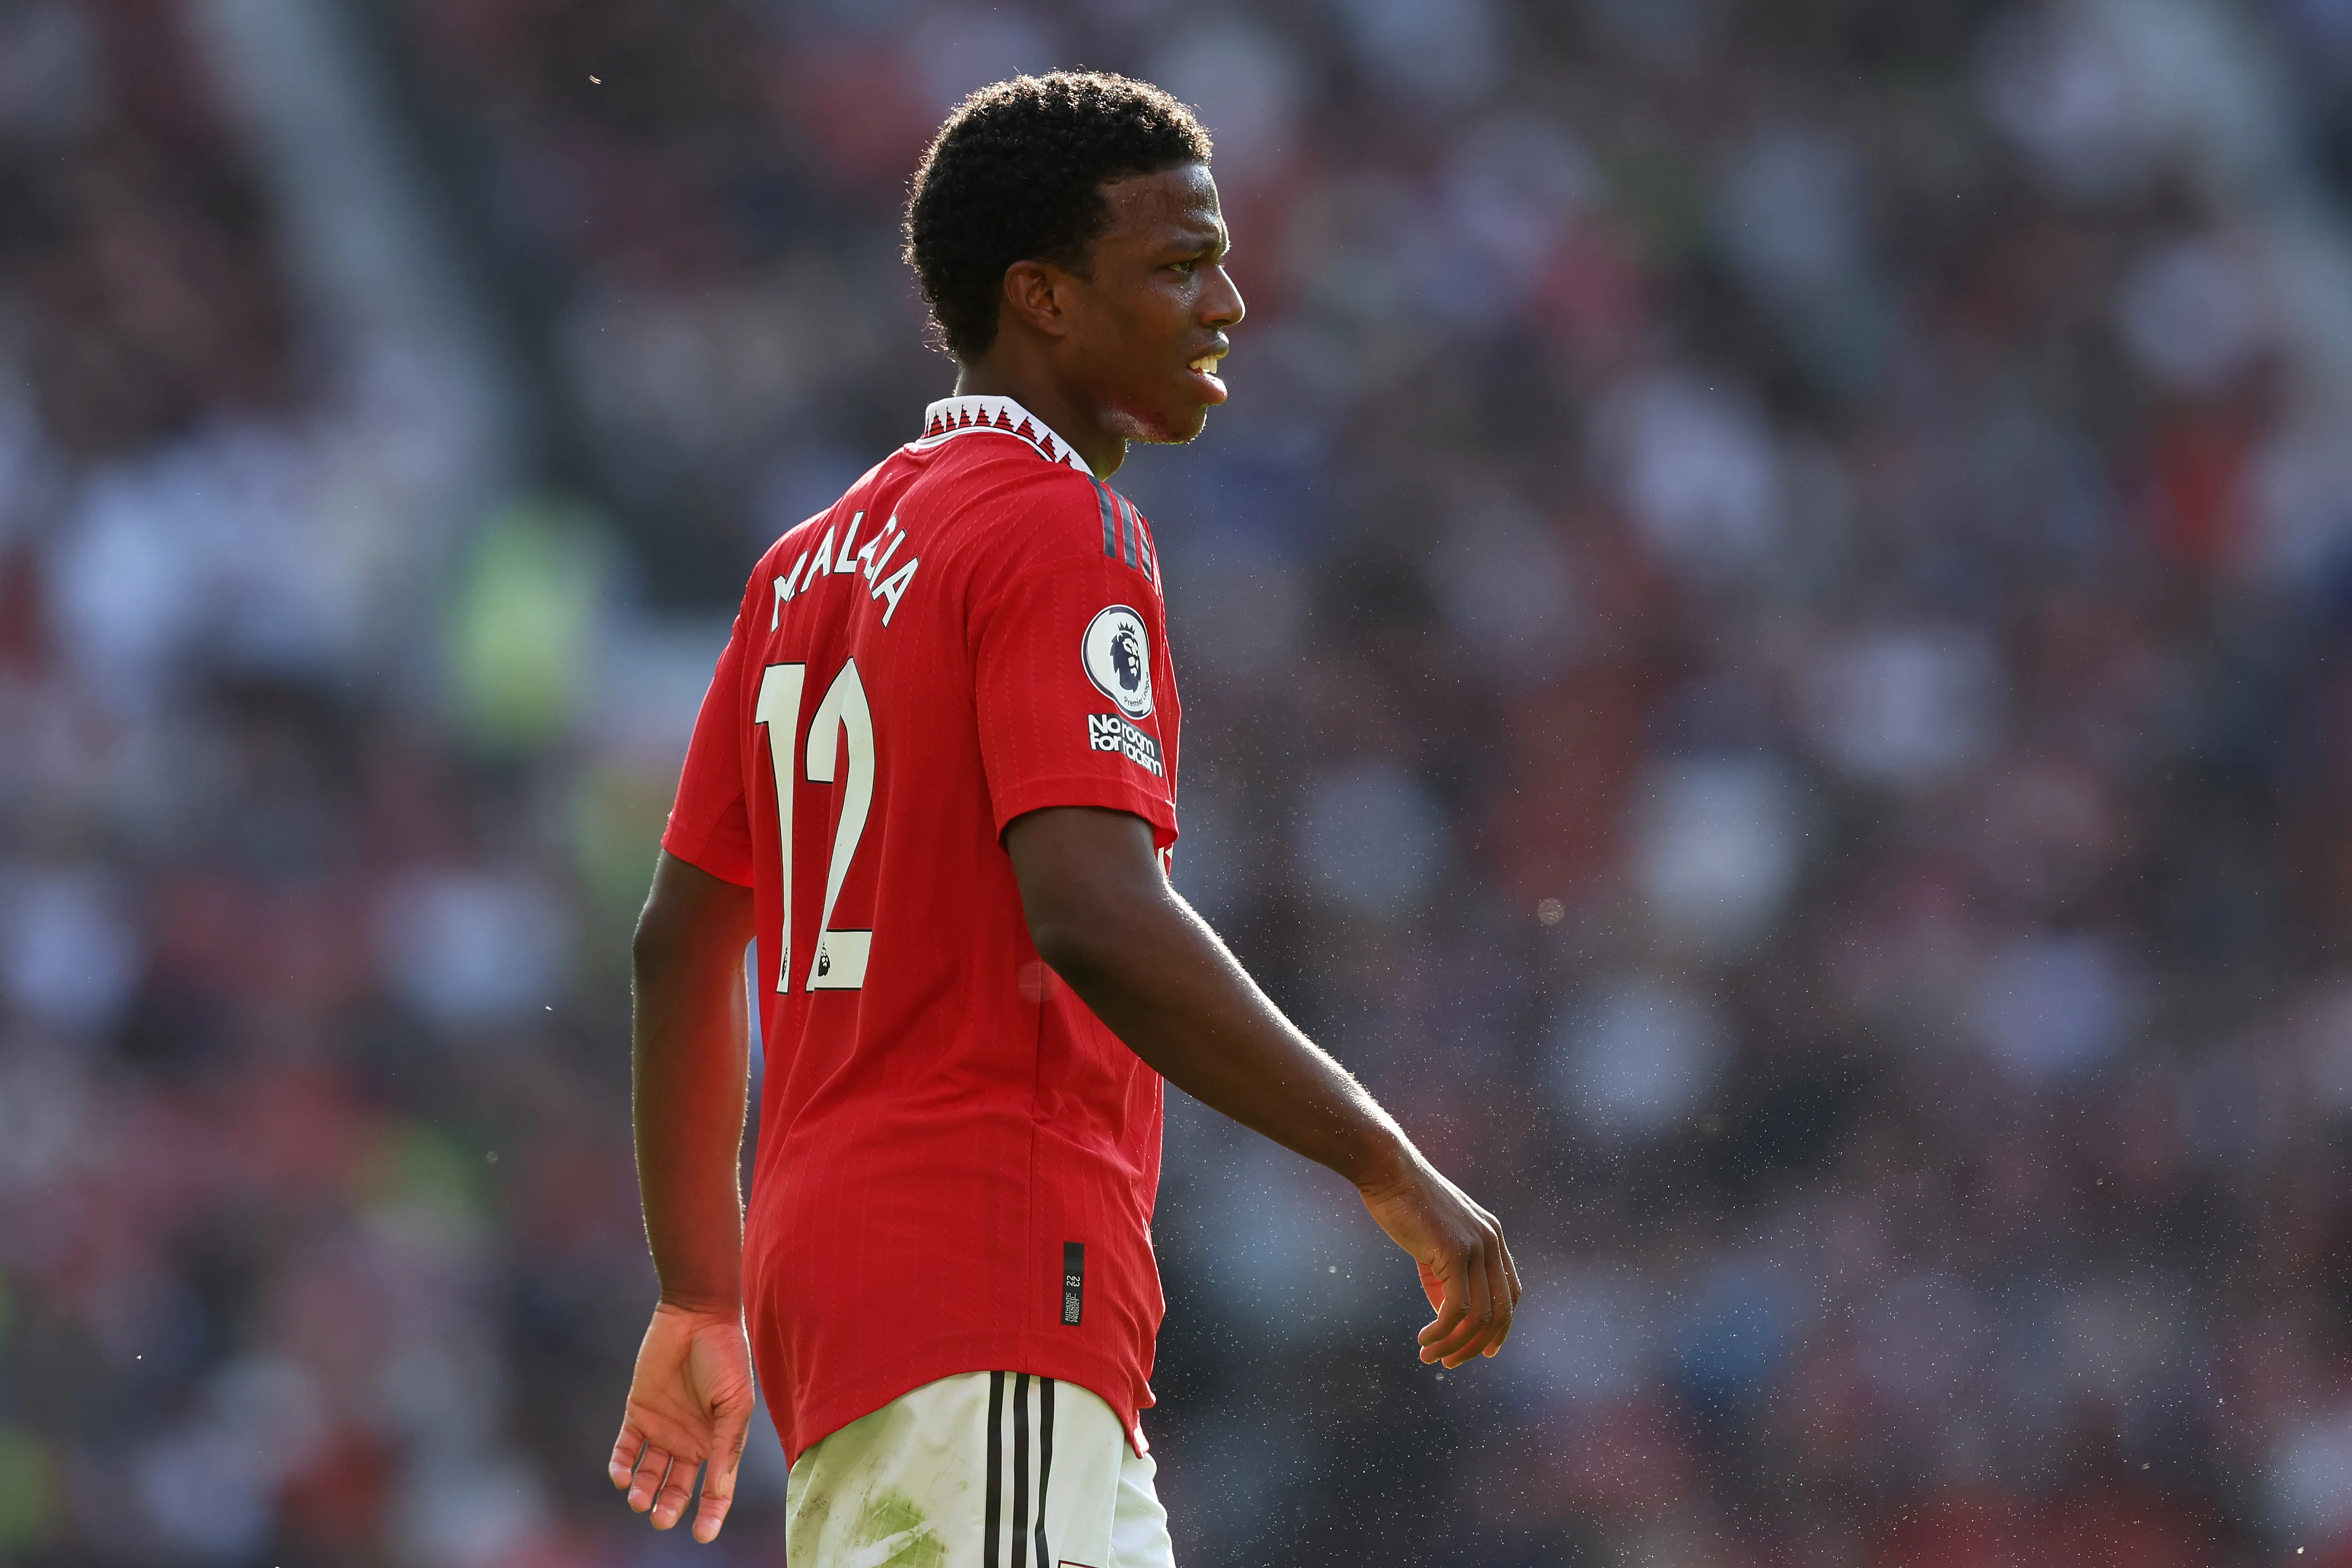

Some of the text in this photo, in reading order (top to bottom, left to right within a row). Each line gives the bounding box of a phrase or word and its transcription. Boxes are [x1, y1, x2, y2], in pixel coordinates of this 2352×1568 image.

[1124, 671, 1150, 707] Premier League
[1088, 715, 1155, 757] No room
[1122, 739, 1163, 778] racism
[755, 656, 876, 995] 12
